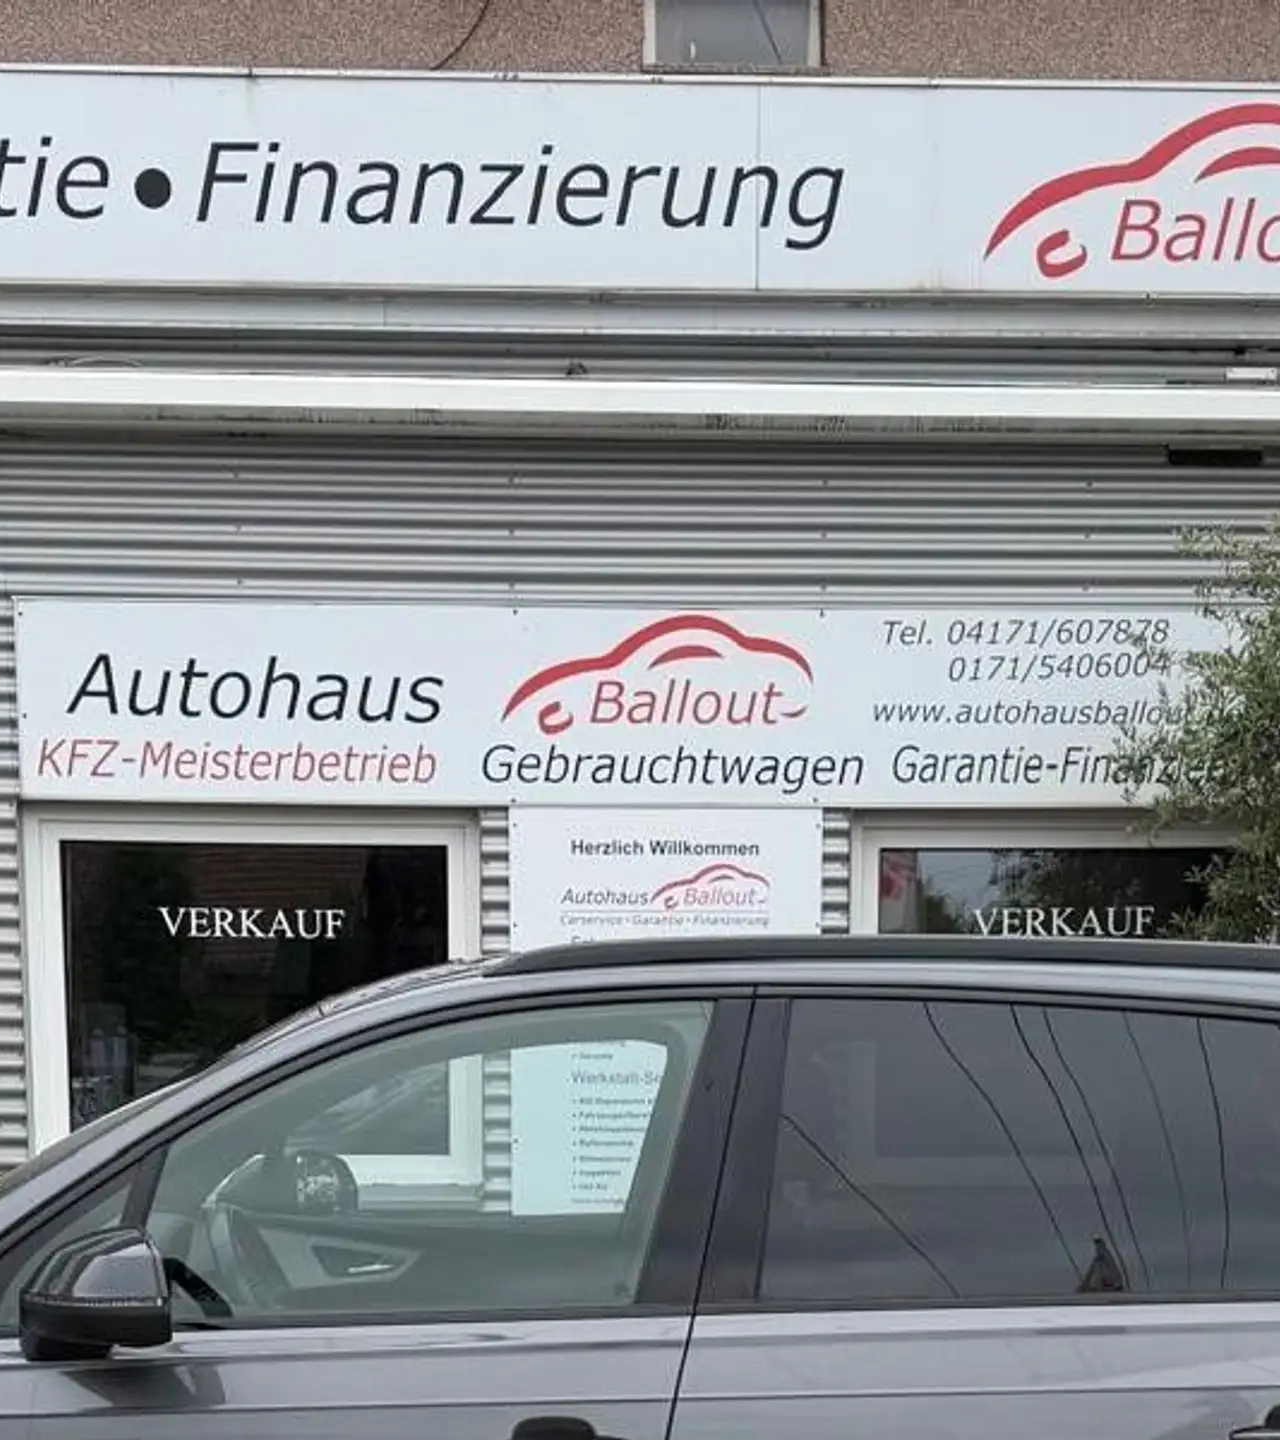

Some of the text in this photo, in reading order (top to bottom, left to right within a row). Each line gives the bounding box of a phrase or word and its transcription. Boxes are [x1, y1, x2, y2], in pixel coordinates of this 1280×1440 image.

[196, 141, 846, 251] Finanzierung
[882, 618, 1170, 649] Tel. 04171/607878
[948, 650, 1169, 684] 0171/5406004
[66, 652, 445, 724] Autohaus
[589, 678, 783, 726] Ballout
[36, 738, 437, 785] KFZ-Meisterbetrieb
[481, 743, 865, 796] Gebrauchtwagen
[570, 839, 760, 857] Herzlich Willkommen
[560, 887, 757, 906] Autohaus Ballout
[159, 907, 346, 940] VERKAUF
[974, 906, 1156, 937] VERKAUF
